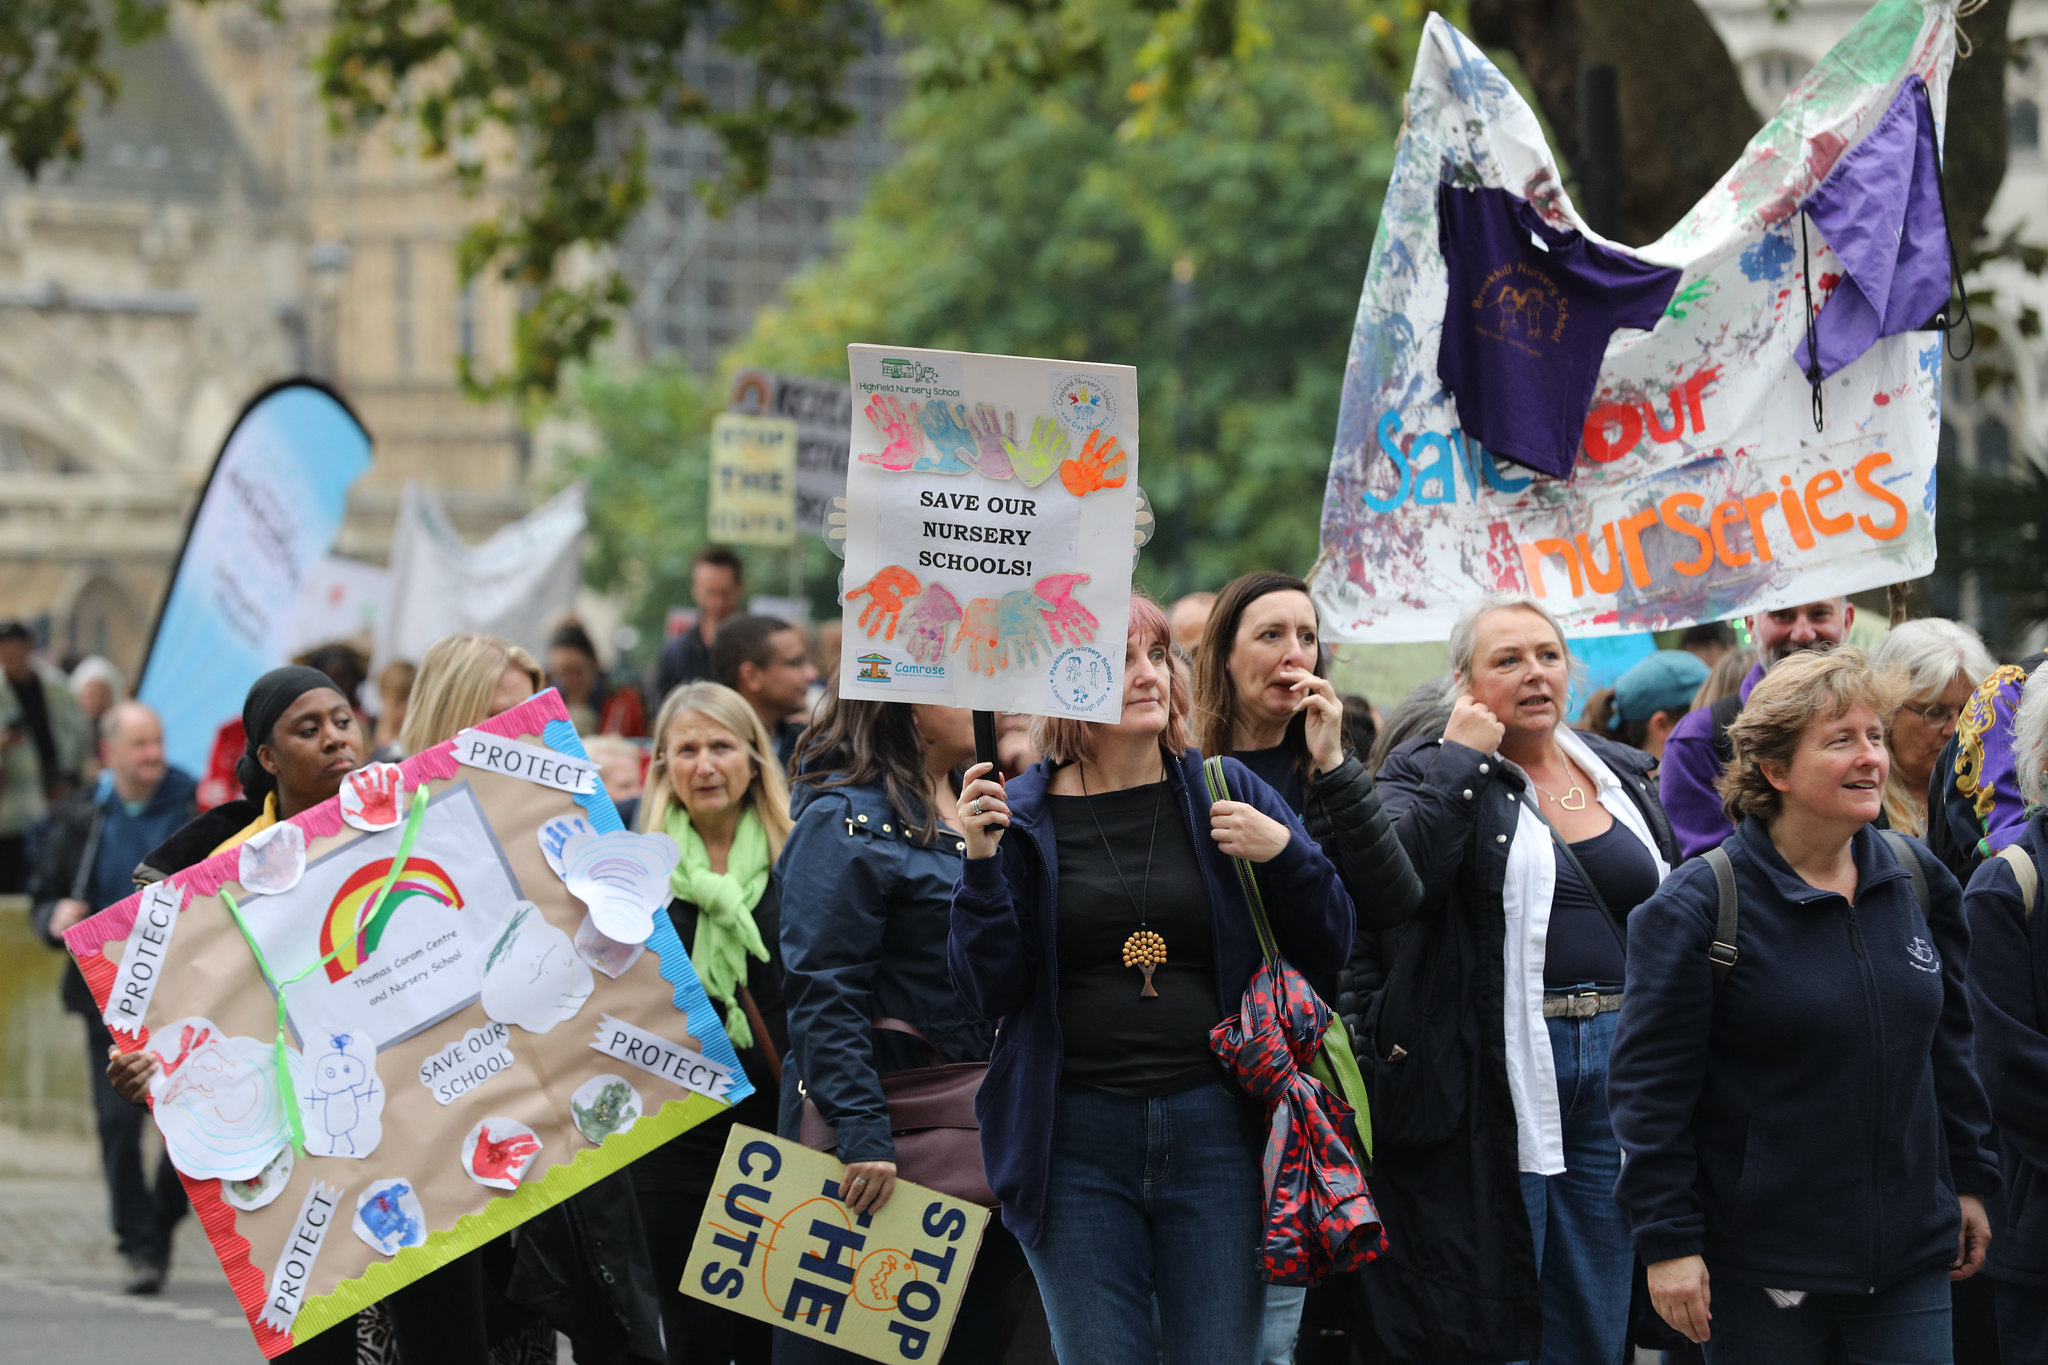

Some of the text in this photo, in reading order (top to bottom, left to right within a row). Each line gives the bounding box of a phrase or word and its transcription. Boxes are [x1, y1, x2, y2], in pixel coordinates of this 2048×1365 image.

[1551, 297, 1569, 343] School
[859, 382, 960, 398] Highfield Nursery School
[1074, 377, 1101, 392] Nursery
[1101, 390, 1113, 412] School
[1583, 363, 1724, 462] our
[1072, 421, 1084, 432] Day
[920, 491, 1036, 516] SAVE OUR
[1520, 452, 1909, 599] nurseries
[923, 521, 1031, 546] NURSERY
[919, 551, 1032, 576] SCHOOLS!
[895, 661, 945, 675] Camrose
[1049, 648, 1074, 676] Parklands
[1101, 657, 1113, 683] School
[1052, 685, 1108, 712] Learning through play
[470, 742, 586, 788] PROTECT
[119, 892, 173, 1017] PROTECT
[353, 930, 457, 989] Thomas Coram Centre
[370, 949, 462, 1006] and Nursery School
[421, 1023, 506, 1083] SAVE OUR
[440, 1052, 512, 1102] SCHOOL
[610, 1031, 723, 1091] PROTECT
[700, 1141, 782, 1299] CUTS
[274, 1191, 332, 1315] PROTECT
[888, 1202, 966, 1360] STOP
